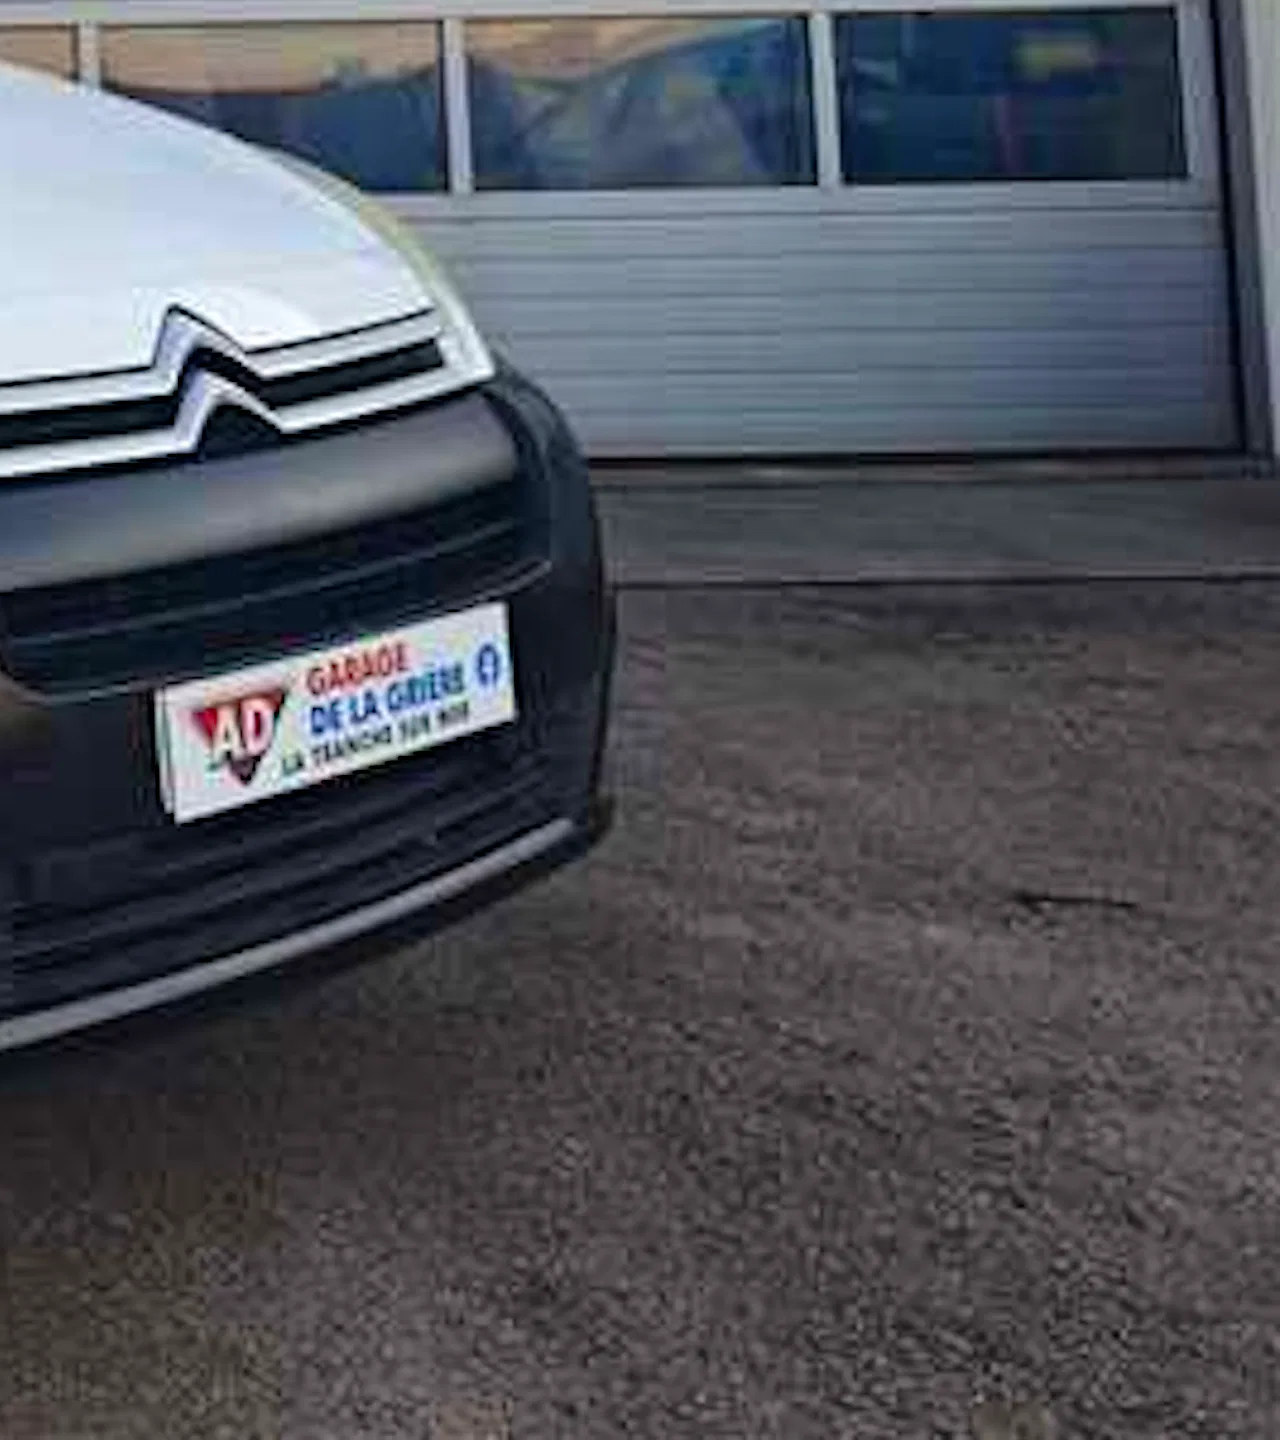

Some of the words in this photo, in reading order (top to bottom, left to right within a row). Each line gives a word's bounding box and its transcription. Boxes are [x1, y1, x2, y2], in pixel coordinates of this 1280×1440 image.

[305, 640, 412, 697] GARAGE
[204, 694, 276, 772] AD
[309, 697, 349, 735] DE
